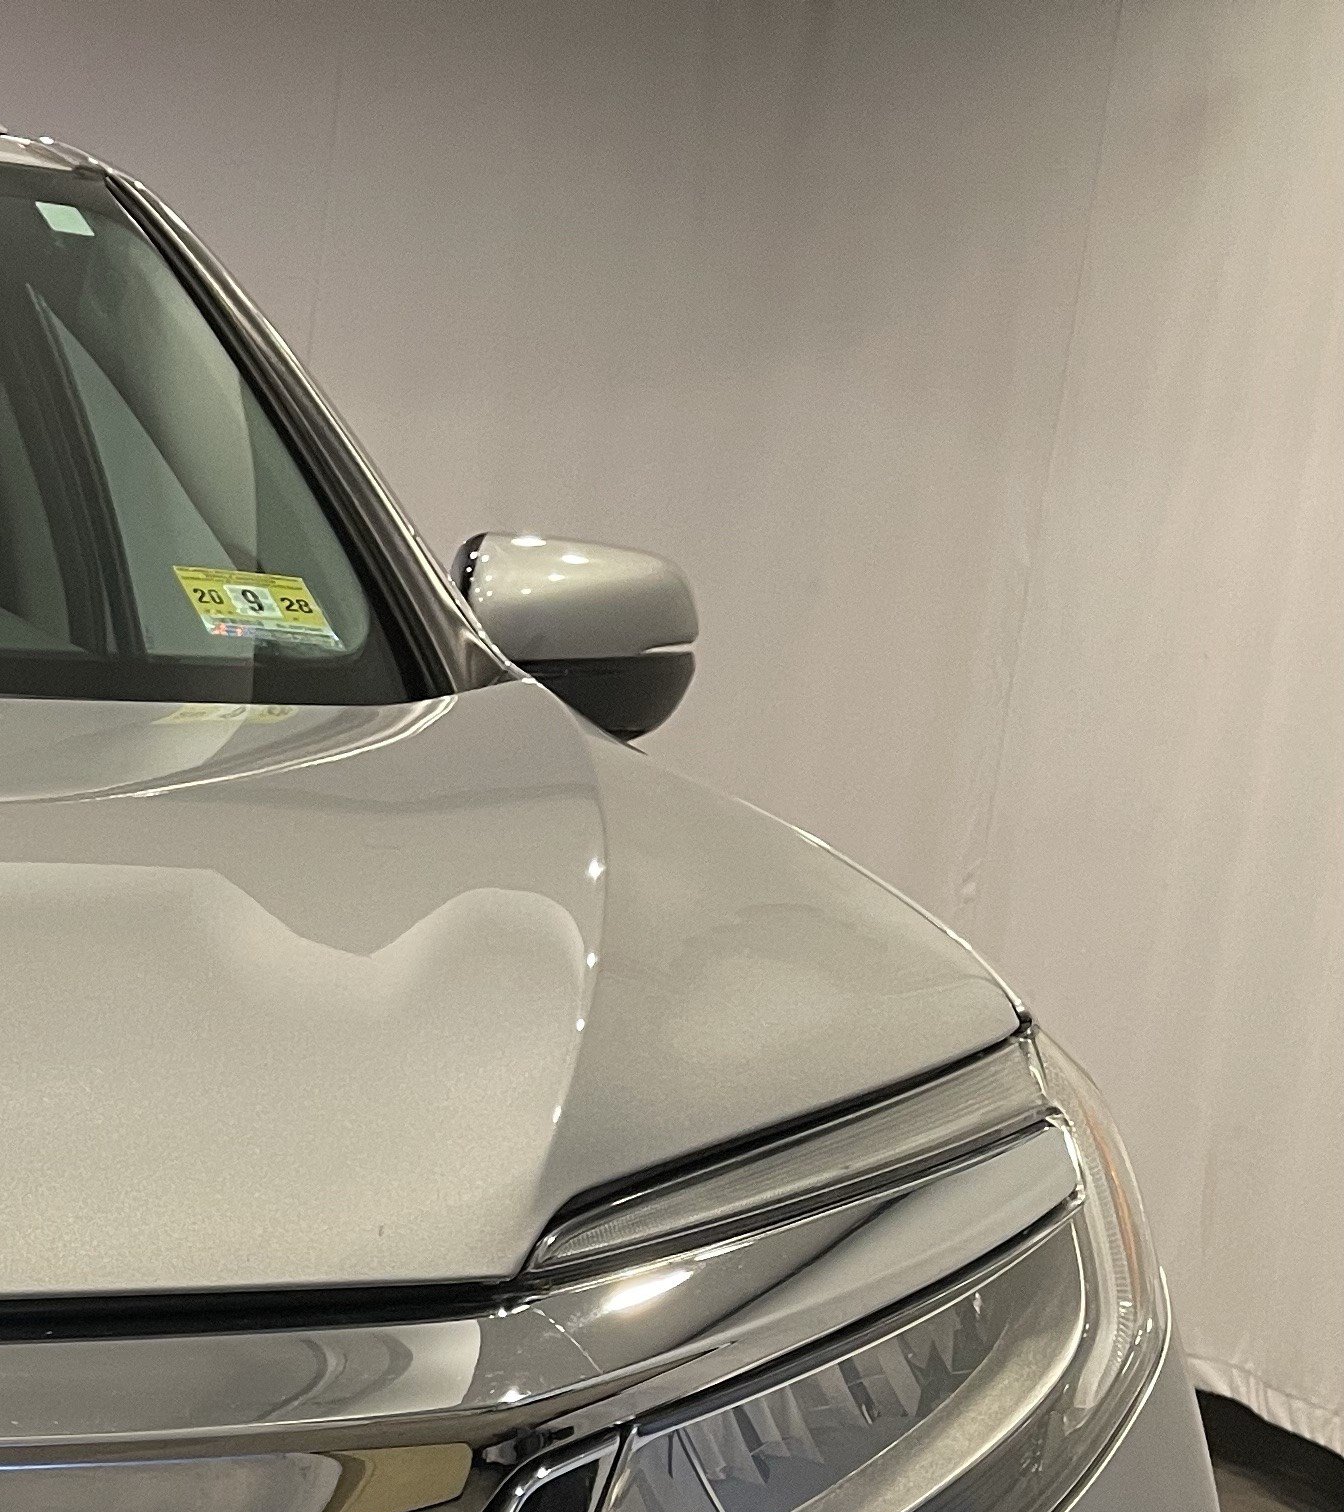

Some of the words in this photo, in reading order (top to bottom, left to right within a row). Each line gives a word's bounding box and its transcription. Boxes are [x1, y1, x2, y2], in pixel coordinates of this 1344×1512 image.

[192, 588, 225, 605] 20
[241, 589, 265, 612] 9
[280, 597, 313, 614] 28
